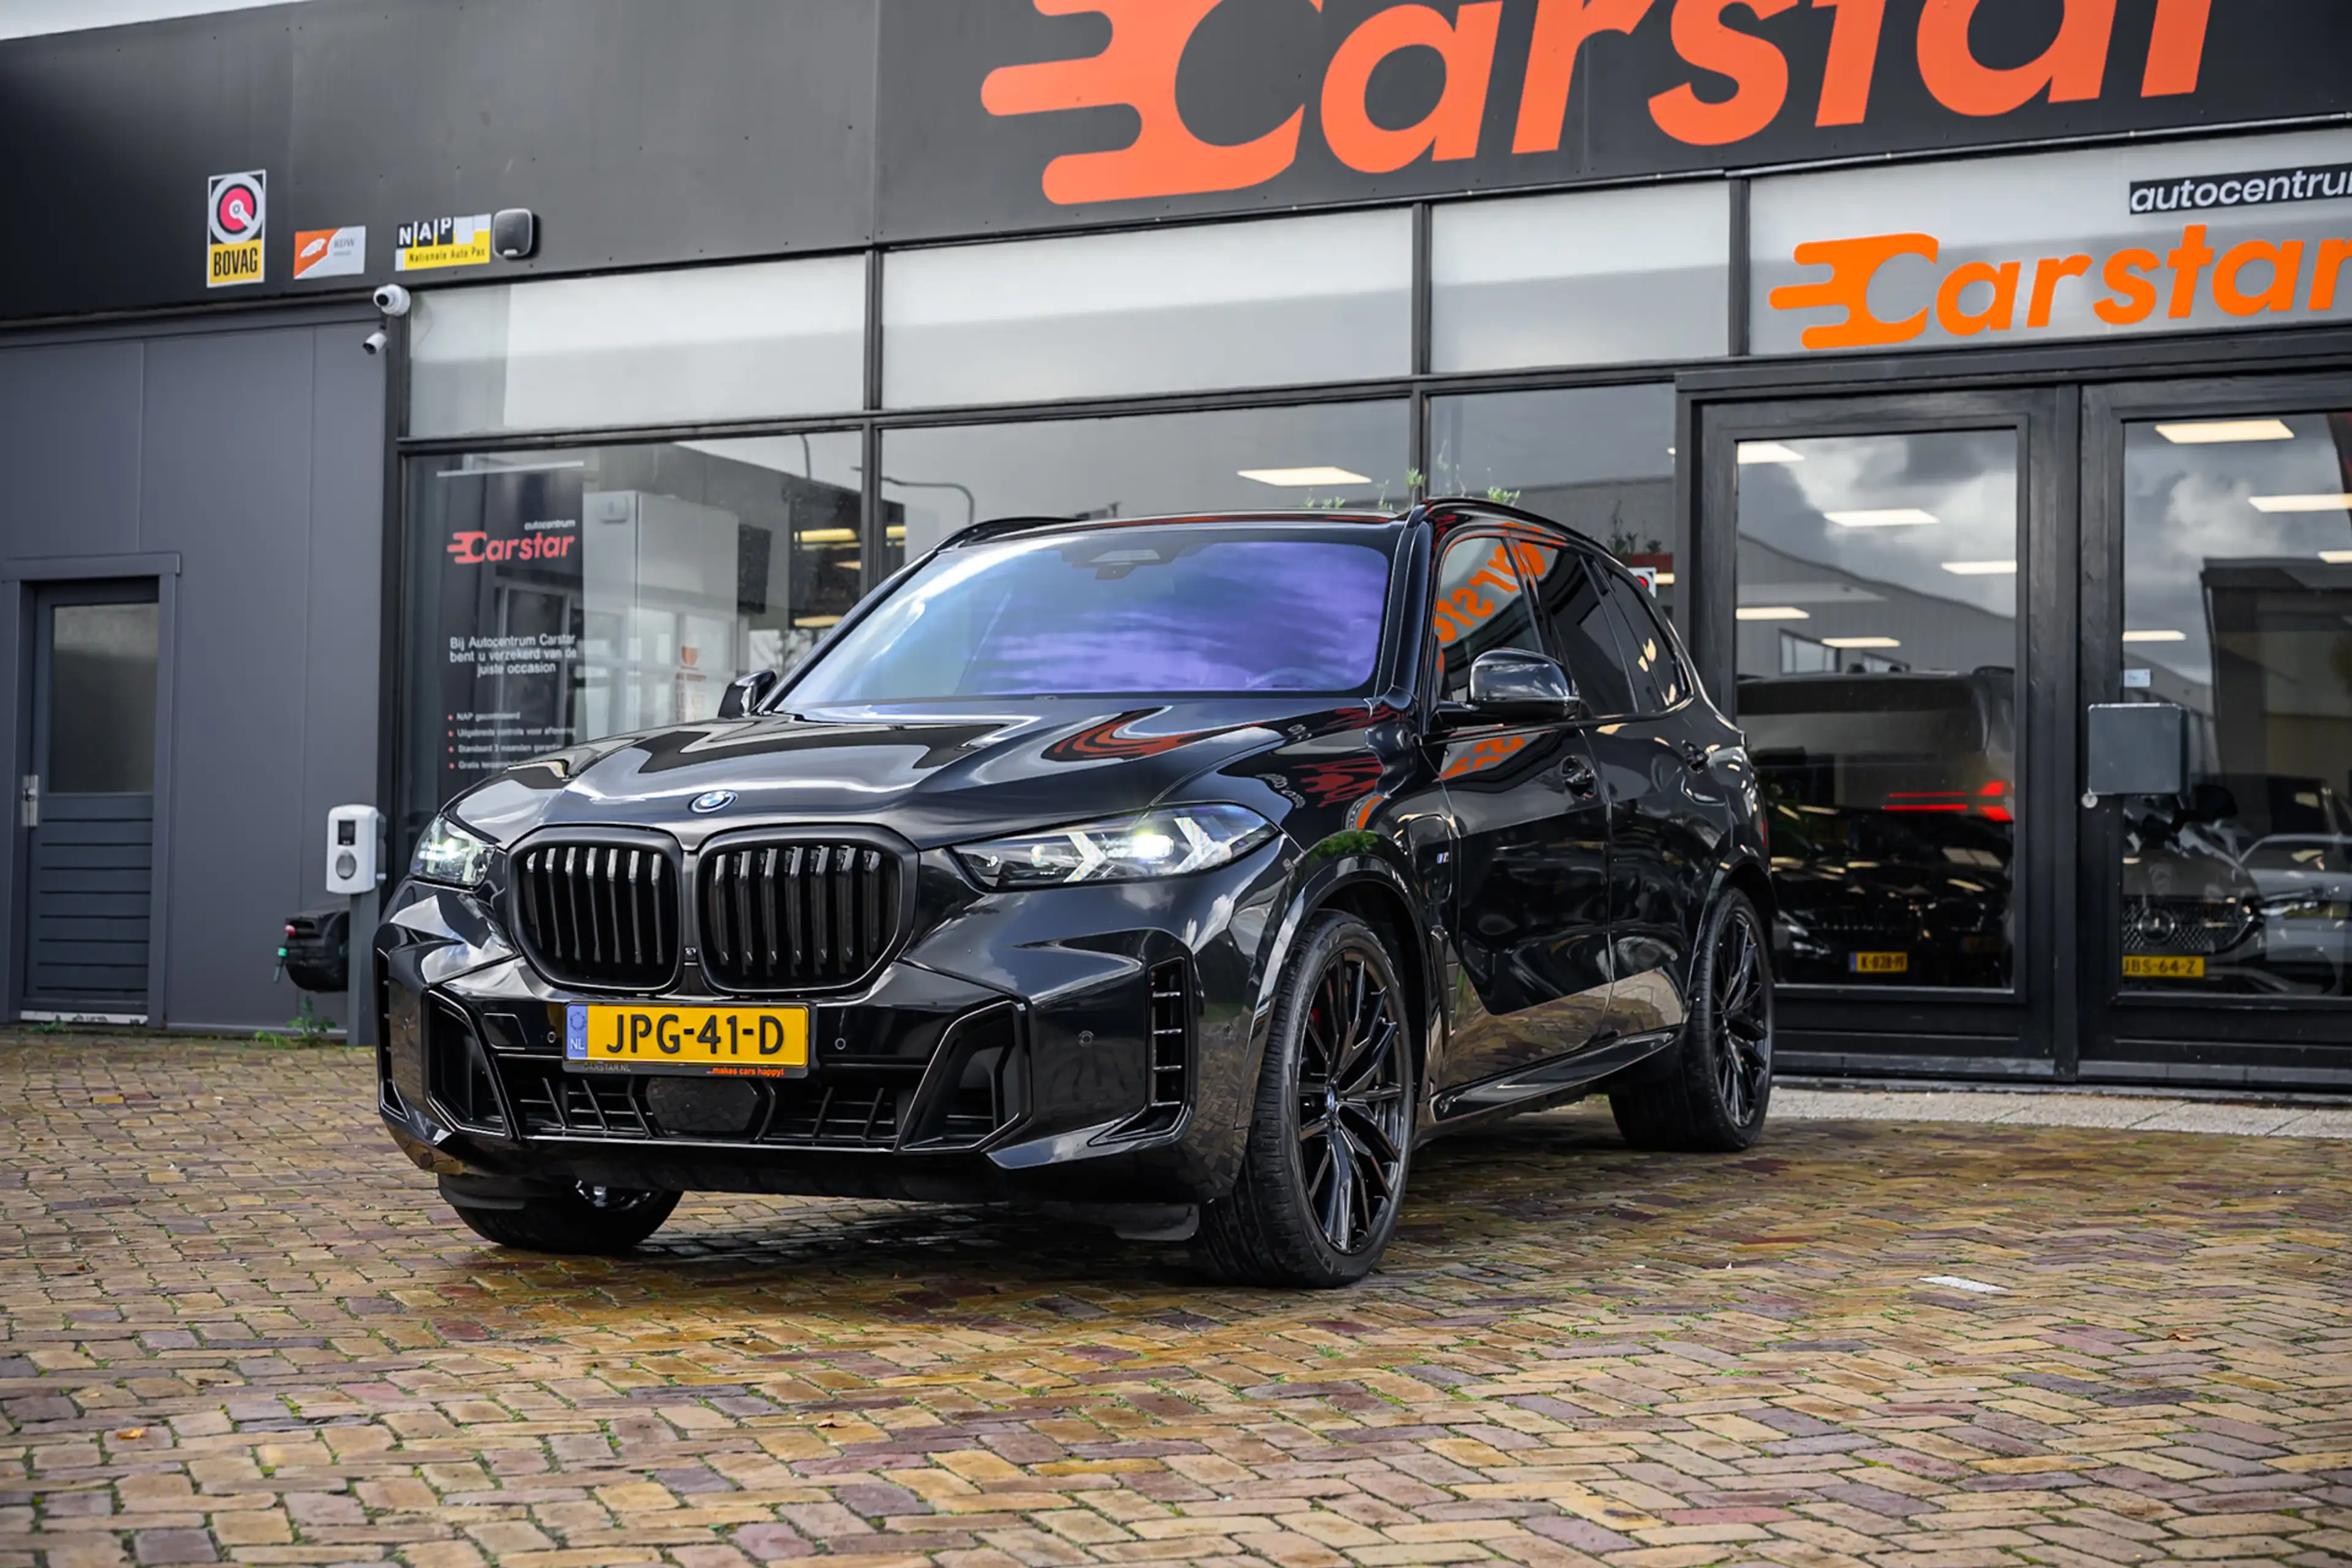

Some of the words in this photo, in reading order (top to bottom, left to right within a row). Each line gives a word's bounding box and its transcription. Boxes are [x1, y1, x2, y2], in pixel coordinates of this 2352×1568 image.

[213, 247, 258, 277] BOVAG
[409, 252, 447, 262] Nationale
[451, 249, 469, 258] Auto
[1769, 224, 2352, 350] Carstar
[524, 519, 576, 531] autocentrum
[447, 531, 576, 564] Carstar
[450, 636, 465, 651] Bij
[469, 635, 536, 649] Autocentrum
[539, 633, 576, 646] Carstar
[450, 650, 475, 663] bent
[478, 652, 486, 662] u
[489, 648, 540, 662] verzekerd
[543, 650, 562, 660] van
[565, 647, 577, 658] de
[477, 663, 504, 678] juiste
[507, 662, 556, 674] occasion
[606, 1014, 784, 1055] JPG-41-D
[570, 1038, 585, 1050] NL
[757, 1066, 784, 1077] happy!
